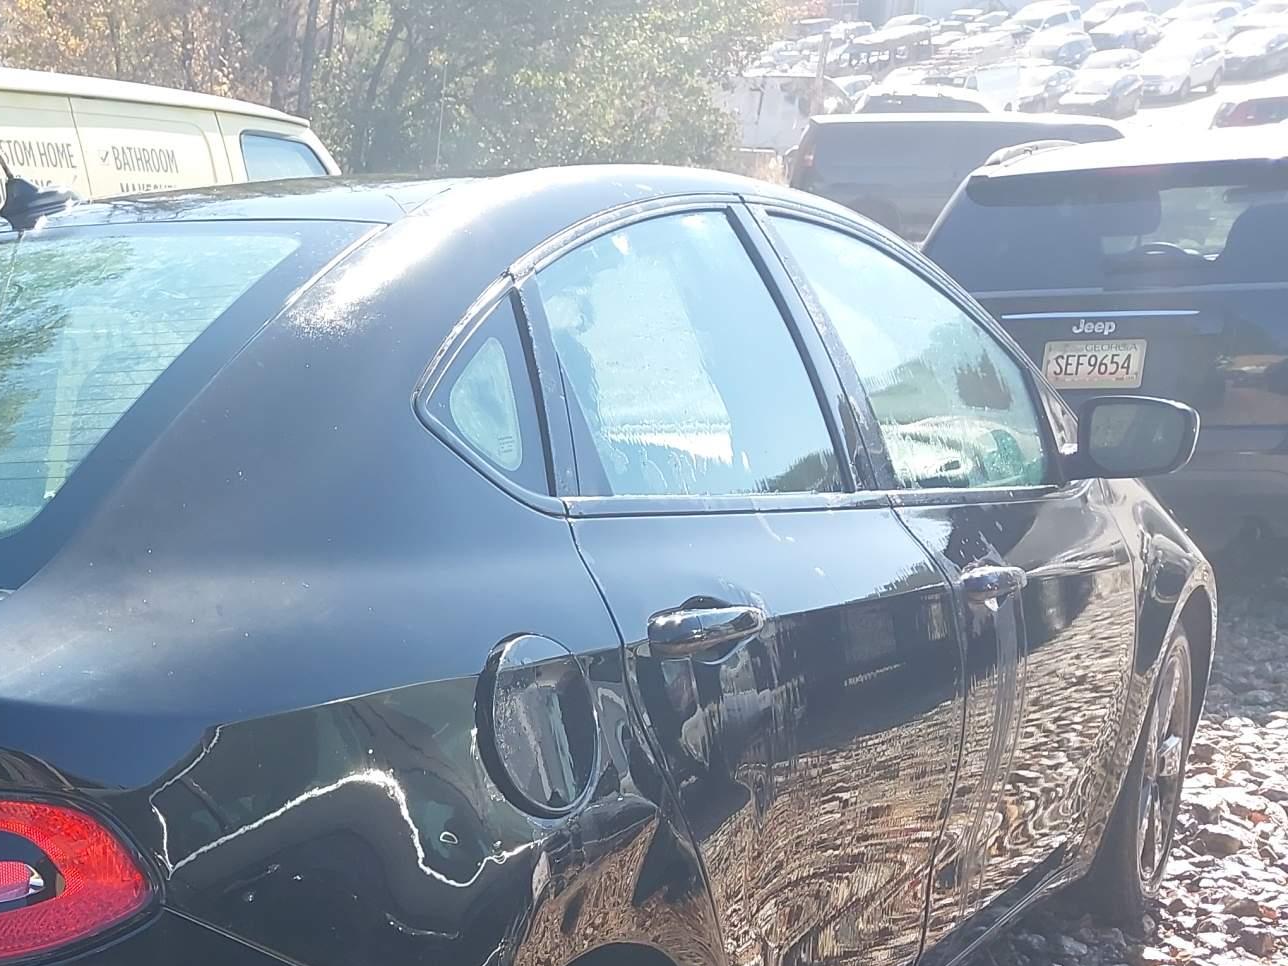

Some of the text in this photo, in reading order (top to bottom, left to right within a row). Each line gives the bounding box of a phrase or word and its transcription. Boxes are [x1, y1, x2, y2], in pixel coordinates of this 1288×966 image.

[37, 141, 77, 169] HOME
[112, 146, 179, 174] BATHROOM
[1072, 319, 1116, 335] Jeep
[1053, 353, 1132, 377] SEF9654
